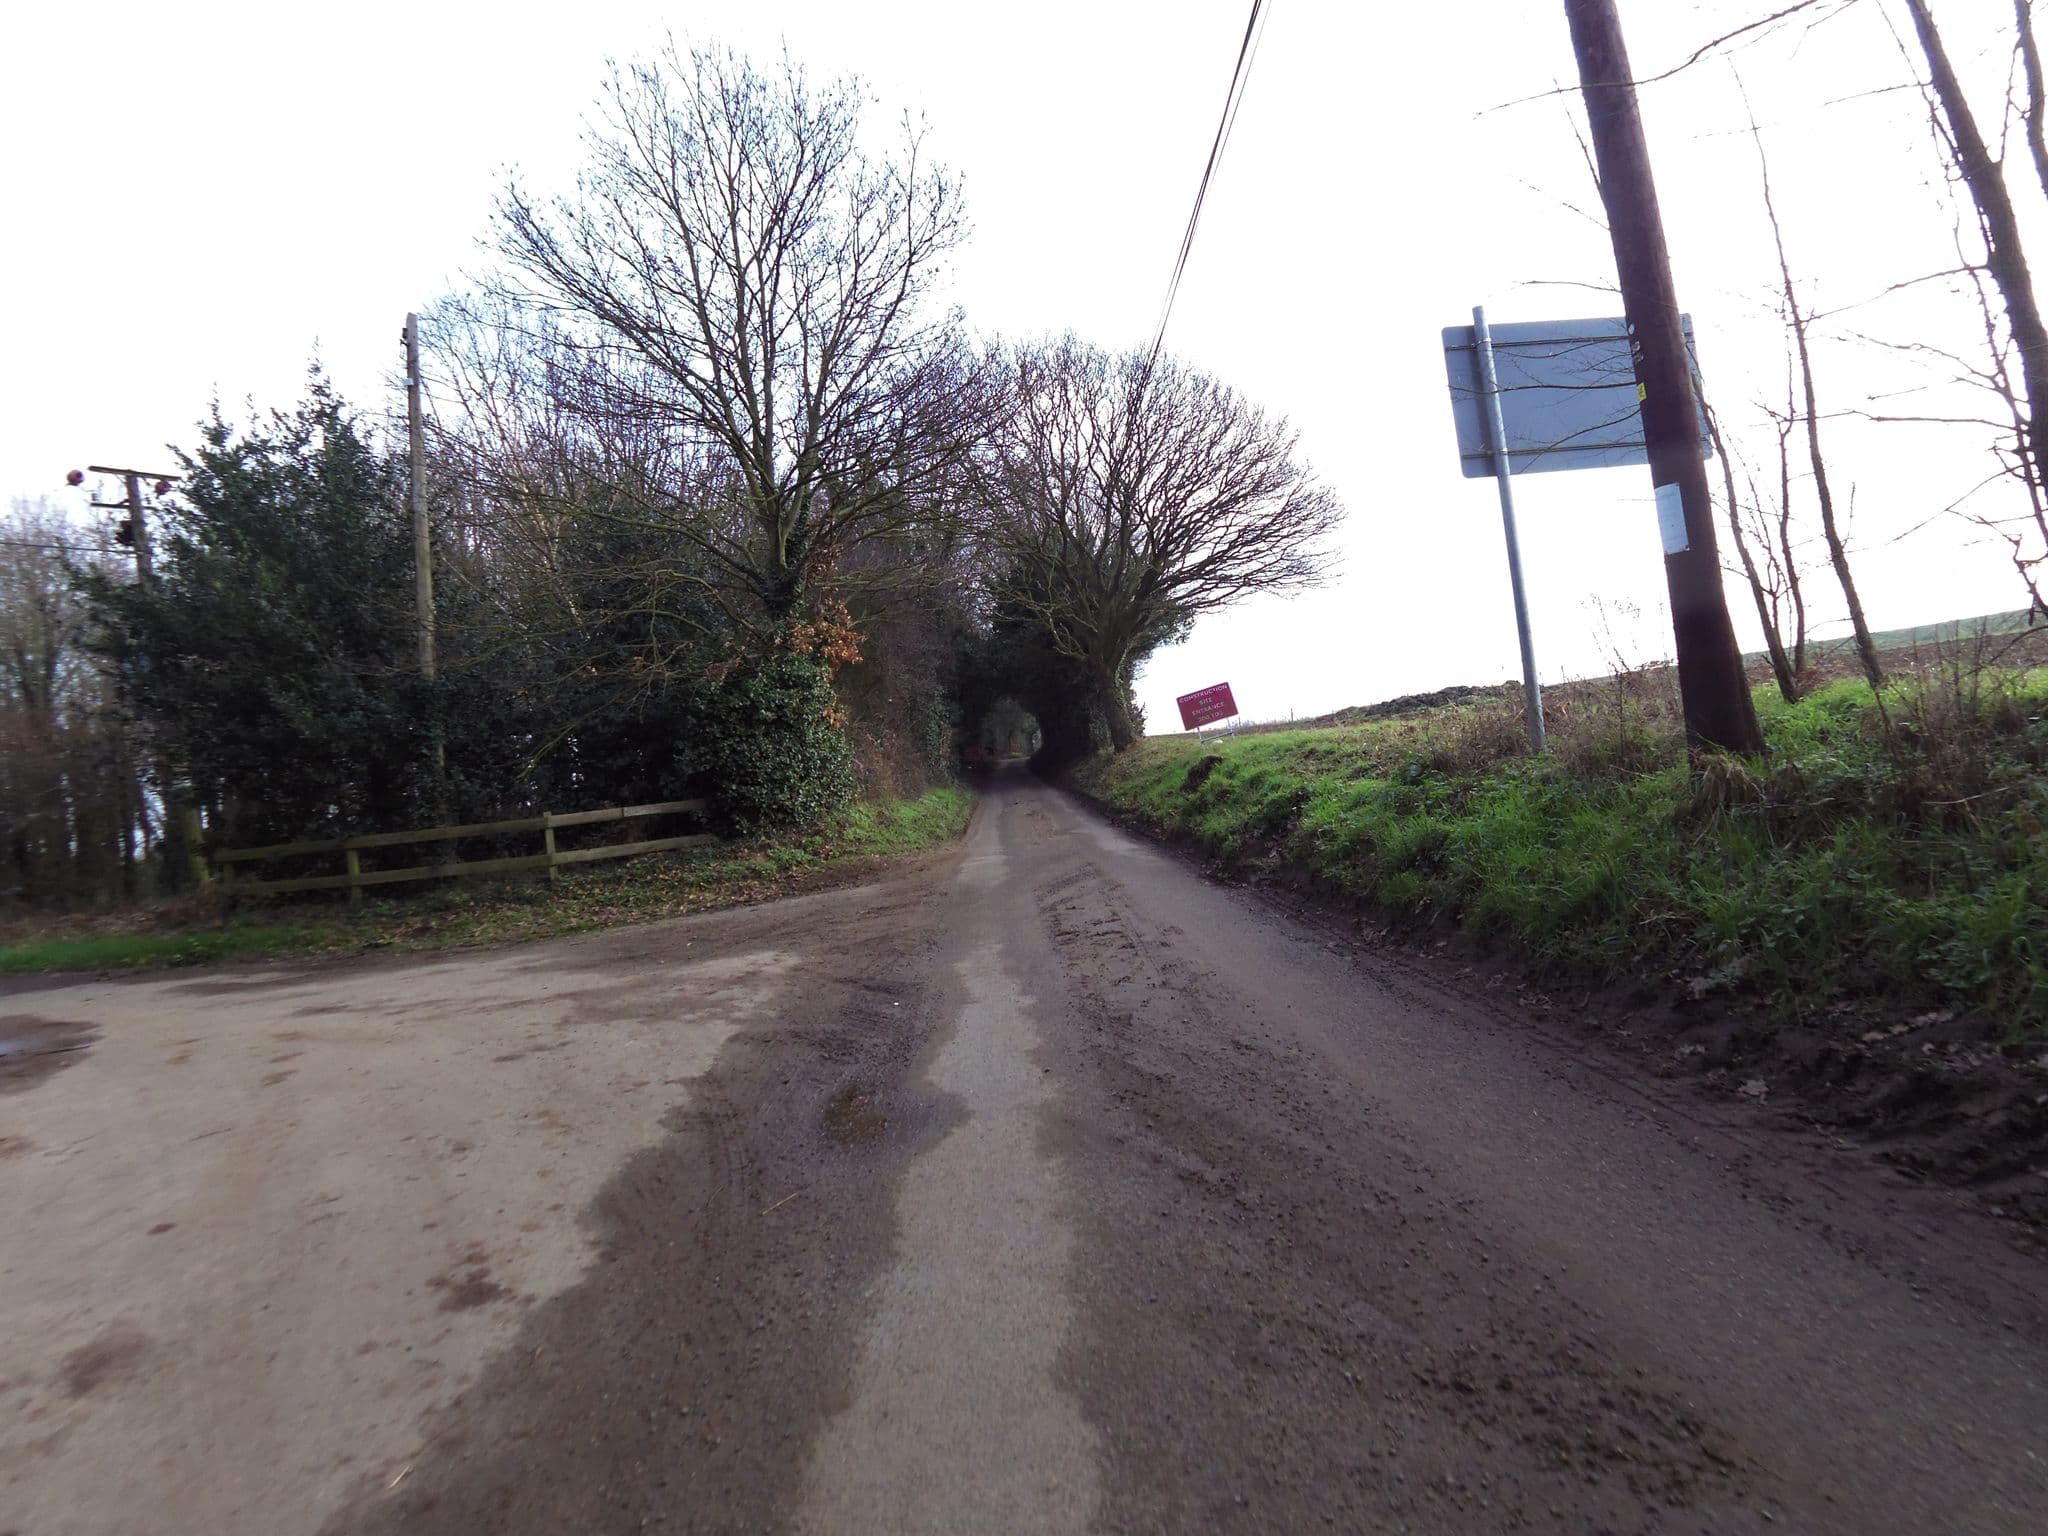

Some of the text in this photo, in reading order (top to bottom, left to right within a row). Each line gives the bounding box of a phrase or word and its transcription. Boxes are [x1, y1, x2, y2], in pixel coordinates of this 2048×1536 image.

[1179, 684, 1228, 703] CONSTRUCTION
[1192, 701, 1225, 716] ENTRANCE
[1199, 697, 1213, 706] SITE
